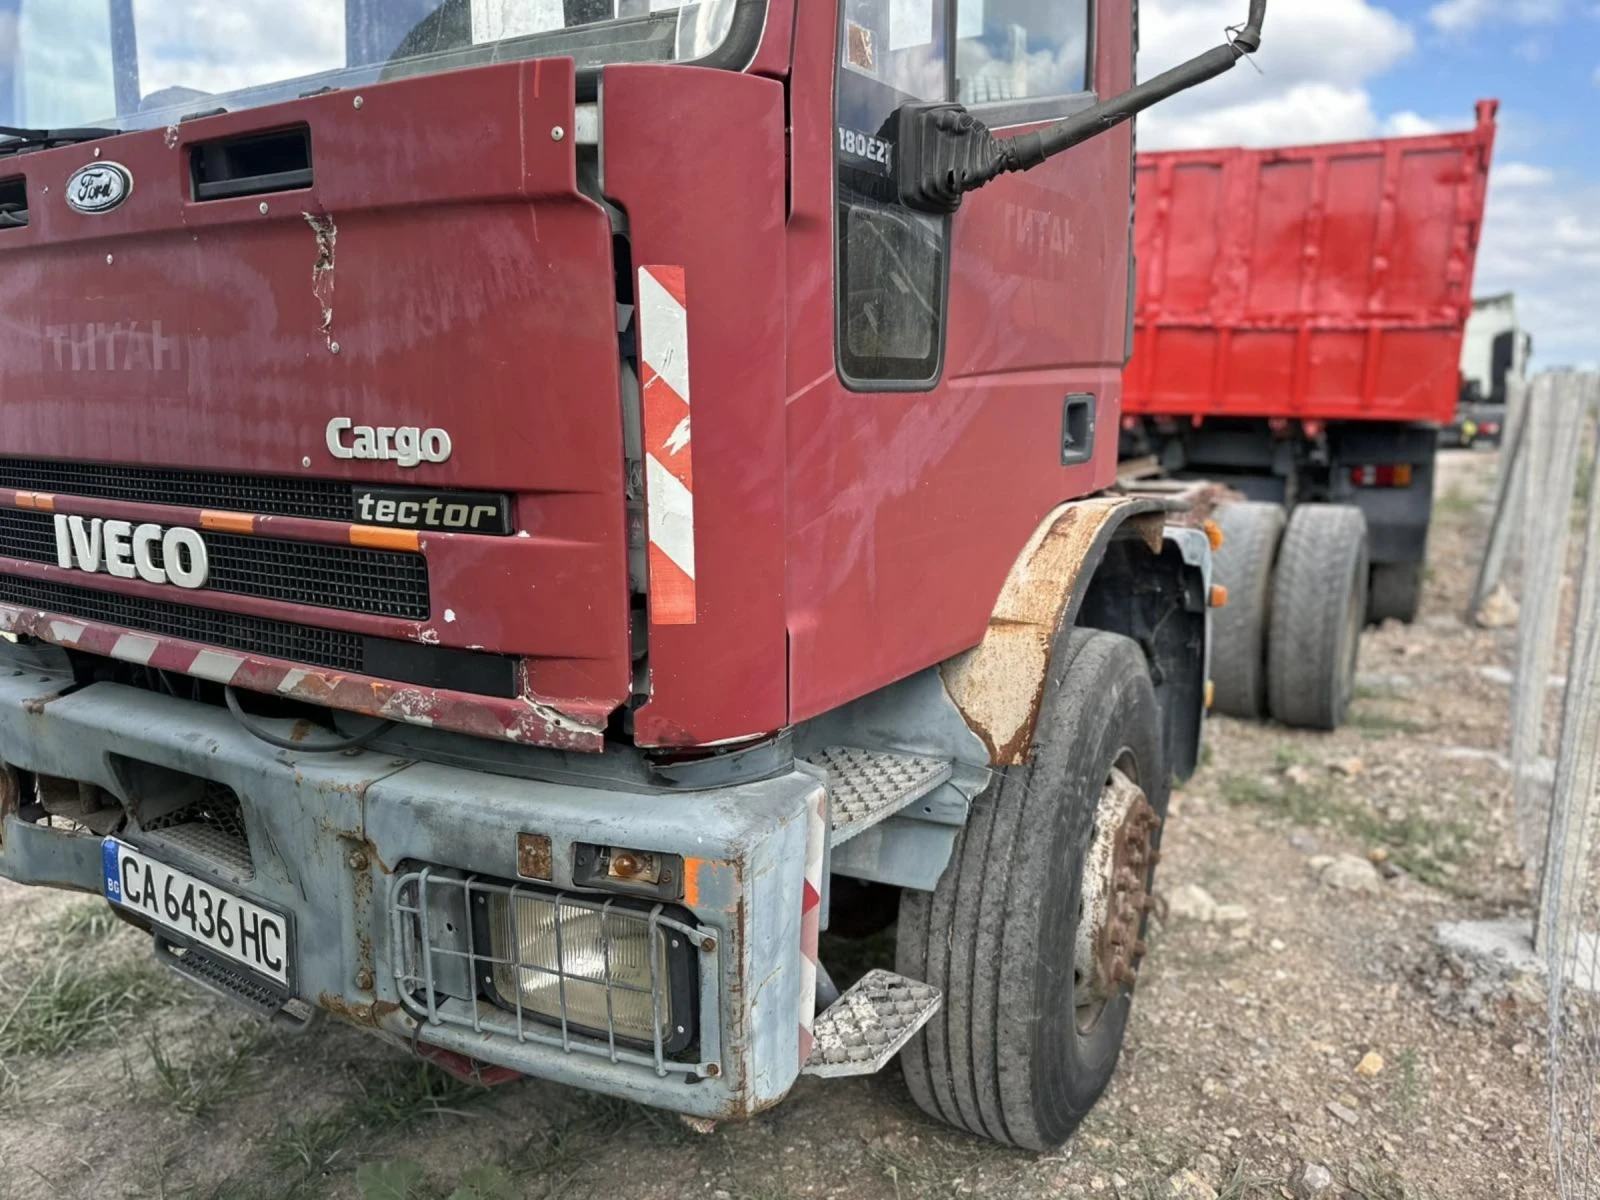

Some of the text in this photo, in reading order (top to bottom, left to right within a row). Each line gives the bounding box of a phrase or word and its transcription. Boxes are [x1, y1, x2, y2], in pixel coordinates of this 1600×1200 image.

[78, 172, 113, 201] Ford
[326, 417, 452, 467] Cargo
[358, 493, 497, 528] tector
[54, 513, 209, 589] IVECO
[107, 878, 120, 894] BG
[122, 856, 282, 972] CA 6436 HC
